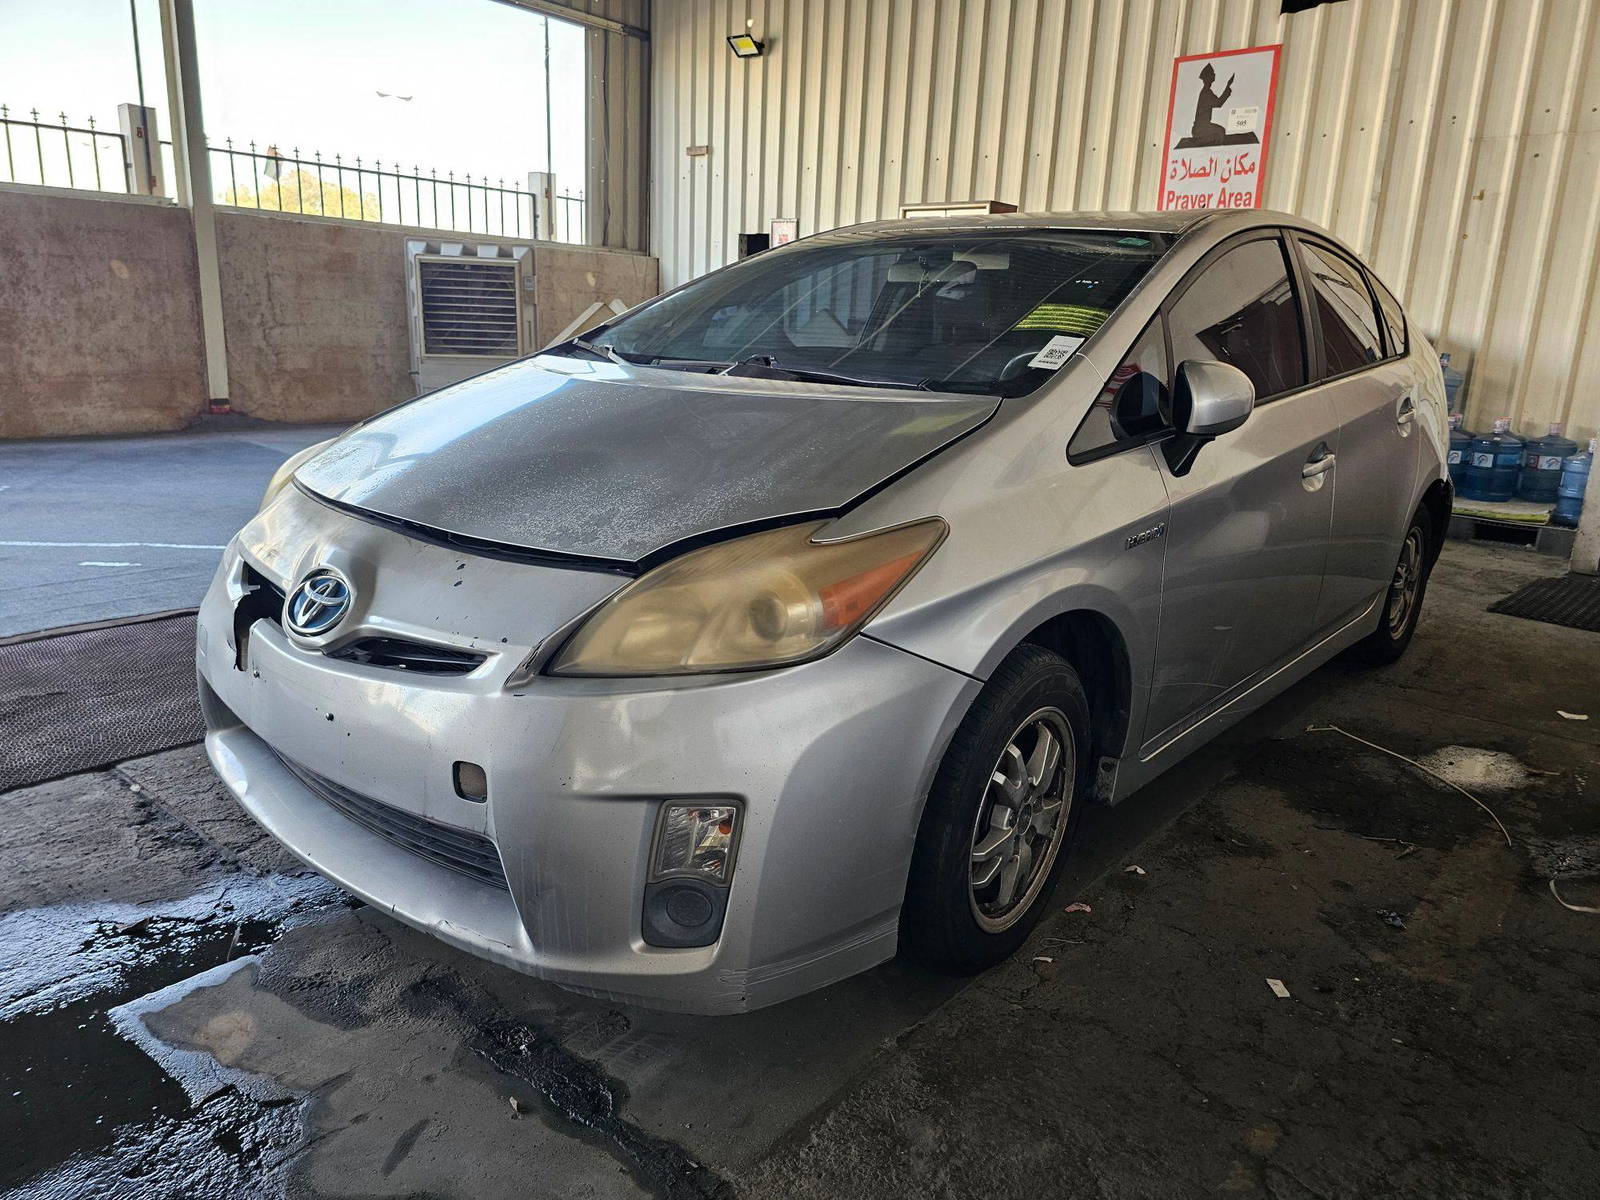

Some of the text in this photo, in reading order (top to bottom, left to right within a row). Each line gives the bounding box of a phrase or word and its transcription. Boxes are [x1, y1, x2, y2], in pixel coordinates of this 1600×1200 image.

[1170, 152, 1255, 183] مكان الصلاة
[1217, 187, 1252, 209] Area
